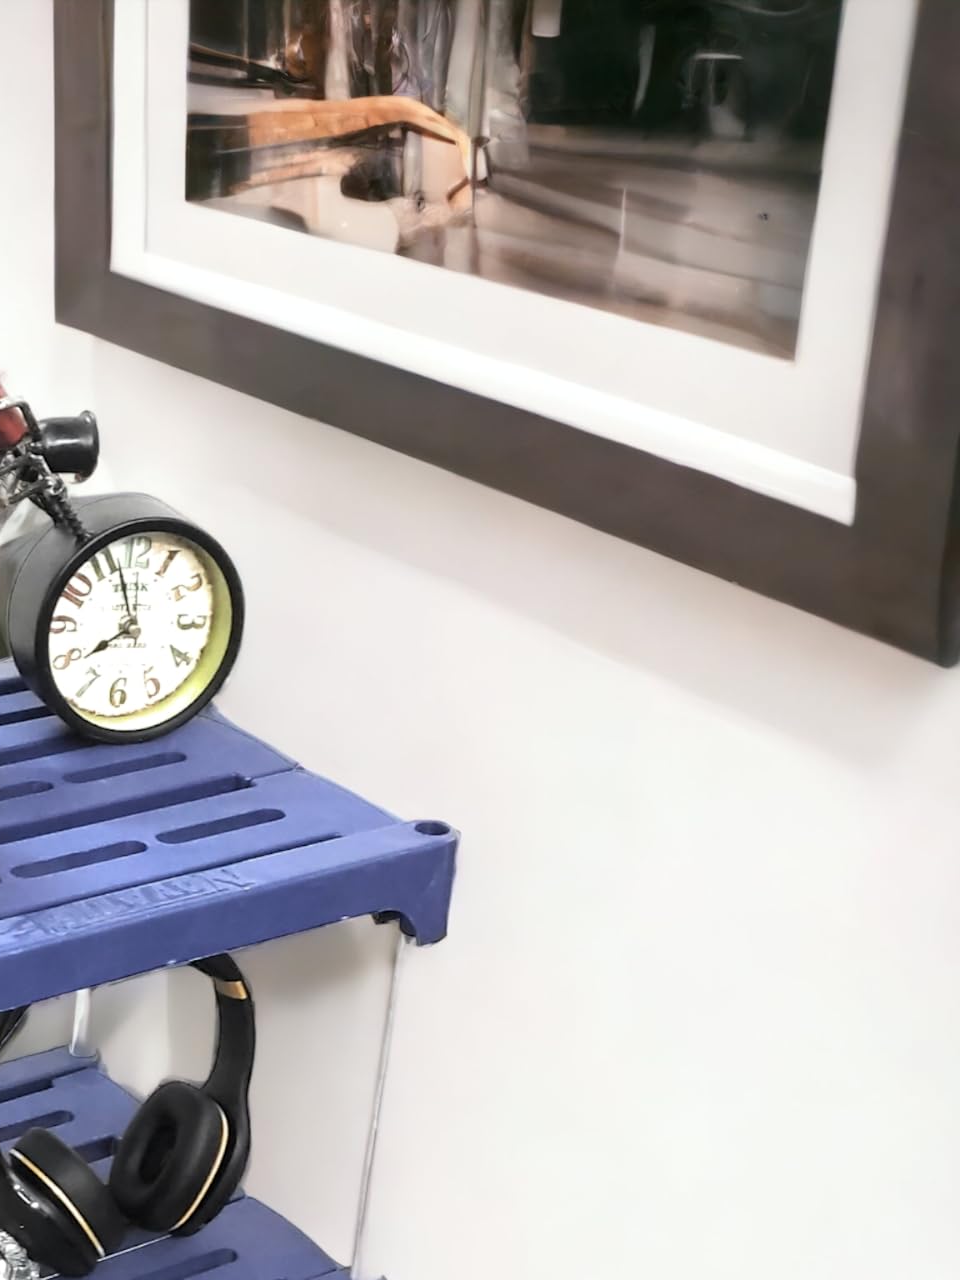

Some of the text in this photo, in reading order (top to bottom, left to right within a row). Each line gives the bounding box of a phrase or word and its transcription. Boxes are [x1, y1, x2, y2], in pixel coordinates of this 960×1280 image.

[90, 547, 118, 581] 11
[123, 536, 152, 569] 12
[155, 550, 181, 576] 1
[61, 572, 93, 609] 10
[172, 574, 203, 601] 2
[49, 615, 78, 634] 9
[177, 614, 207, 630] 3
[53, 648, 82, 670] 8
[170, 644, 192, 667] 4
[76, 667, 101, 698] 7
[109, 678, 127, 708] 6
[144, 666, 161, 698] 5
